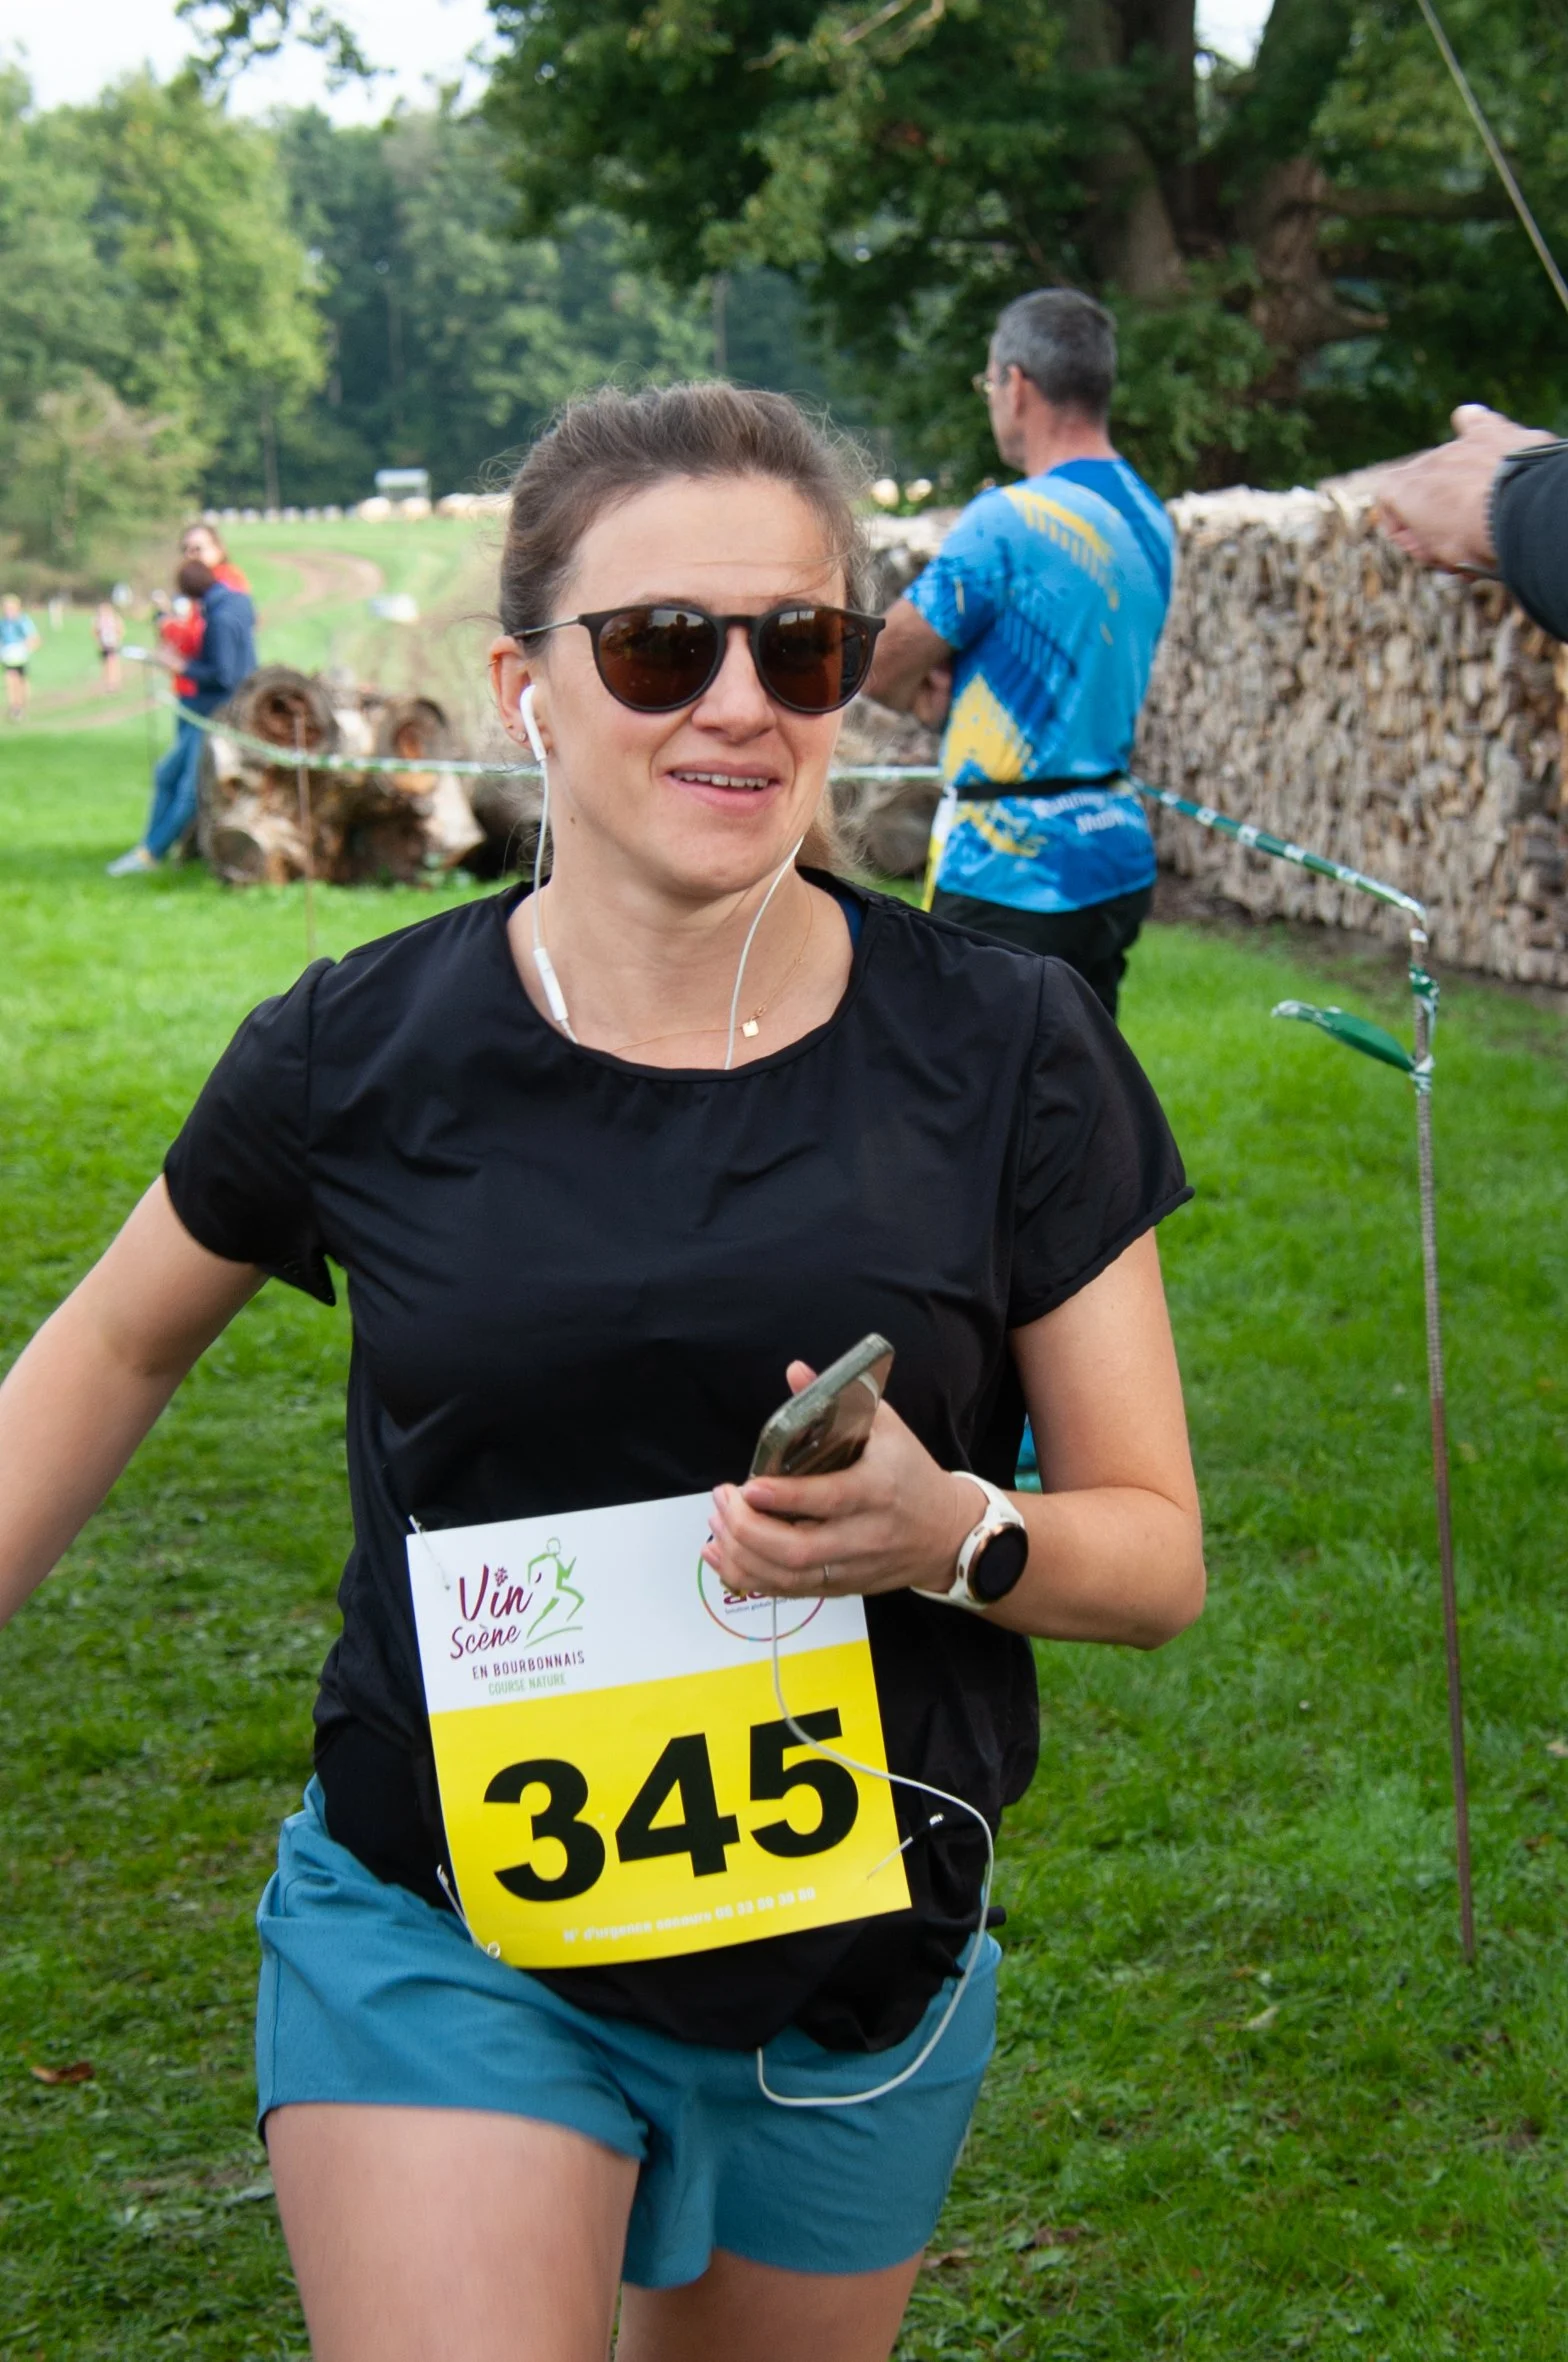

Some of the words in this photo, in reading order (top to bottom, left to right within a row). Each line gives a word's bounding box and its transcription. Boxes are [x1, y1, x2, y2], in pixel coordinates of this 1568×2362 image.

[450, 1624, 521, 1660] Scène
[472, 1664, 488, 1680] EN
[493, 1650, 585, 1677] BOURBONNAIS
[488, 1679, 525, 1697] COURSE
[528, 1672, 566, 1690] NATURE
[483, 1707, 859, 1902] 345
[584, 1922, 652, 1941] d'urgence
